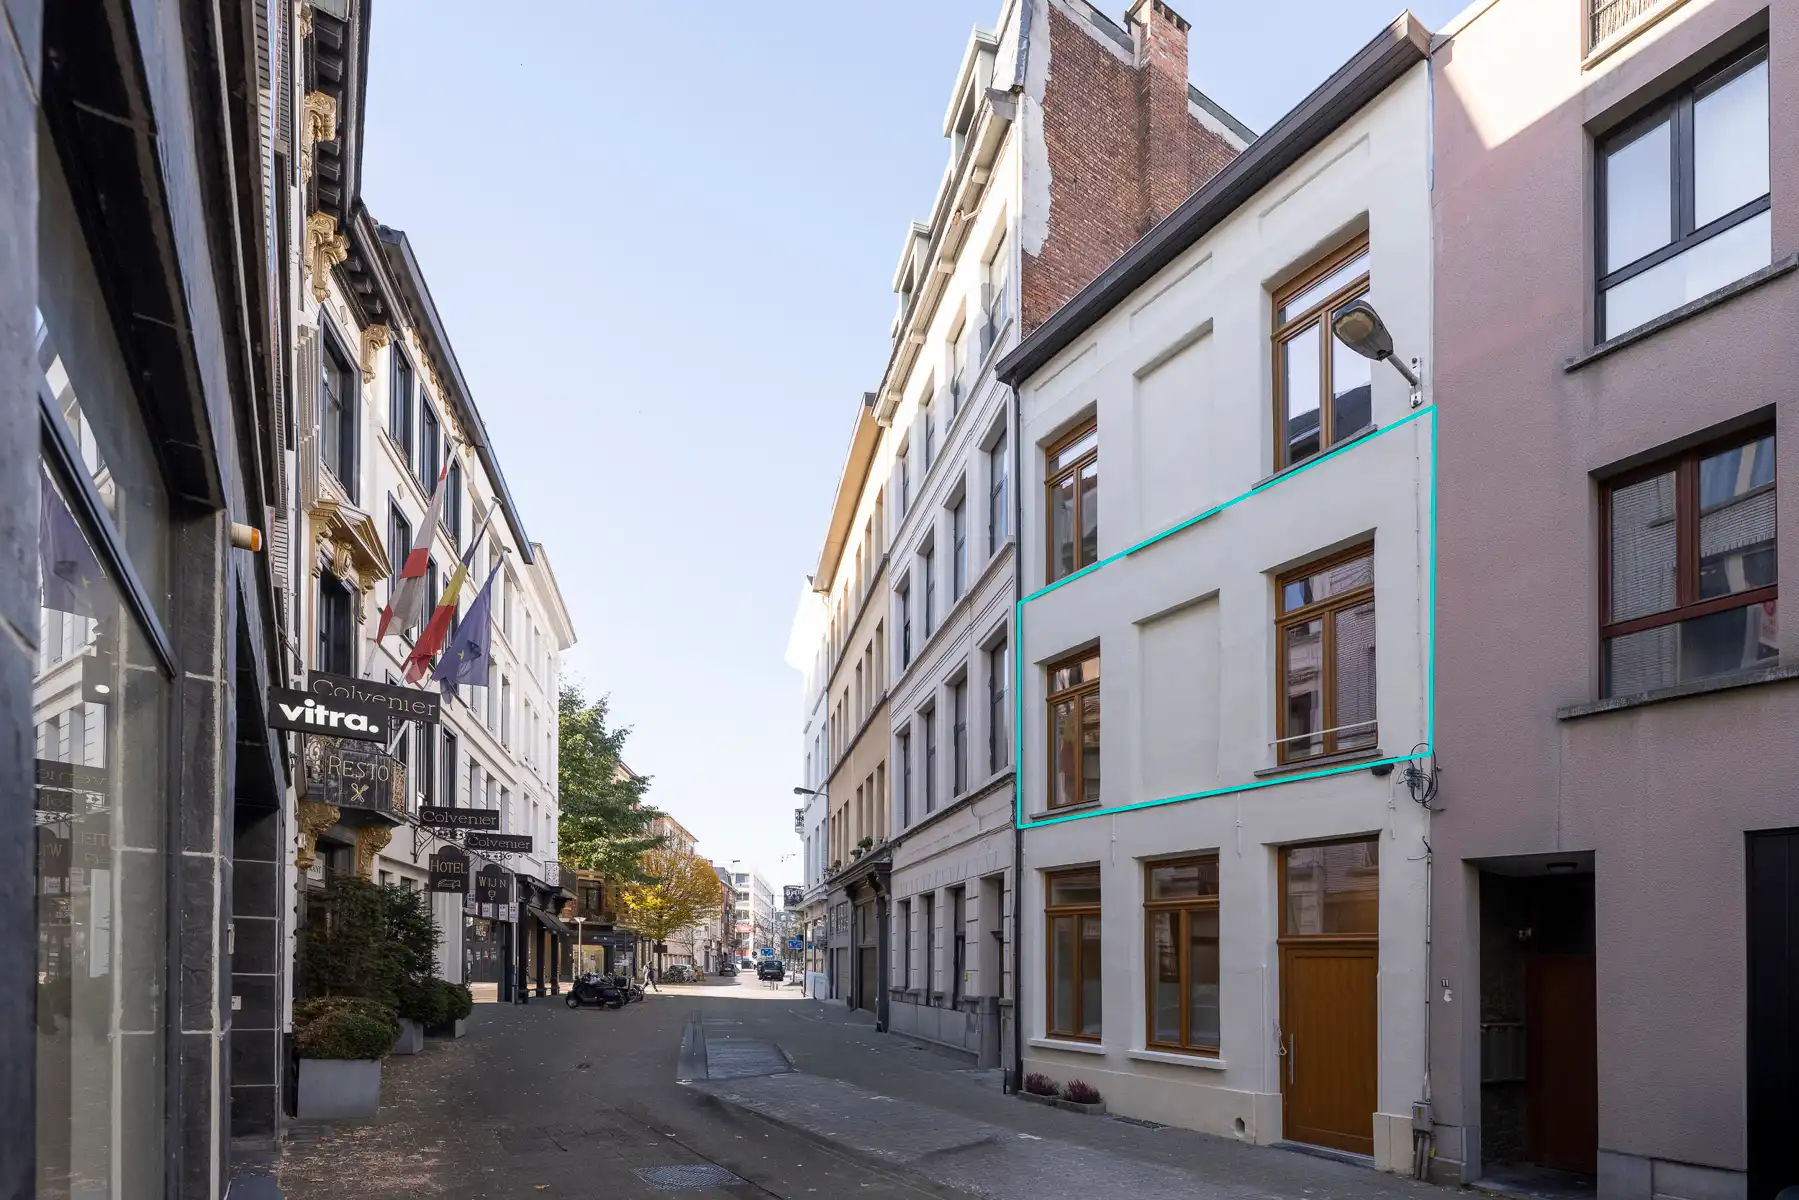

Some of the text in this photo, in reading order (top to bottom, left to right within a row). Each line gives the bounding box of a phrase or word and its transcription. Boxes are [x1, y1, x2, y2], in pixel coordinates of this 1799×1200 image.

[312, 679, 436, 716] Colvenier
[278, 698, 380, 734] vitra.
[328, 755, 389, 781] RESTO
[422, 810, 497, 825] Colvenier
[467, 834, 531, 850] Colvenier
[478, 876, 507, 888] WIJN
